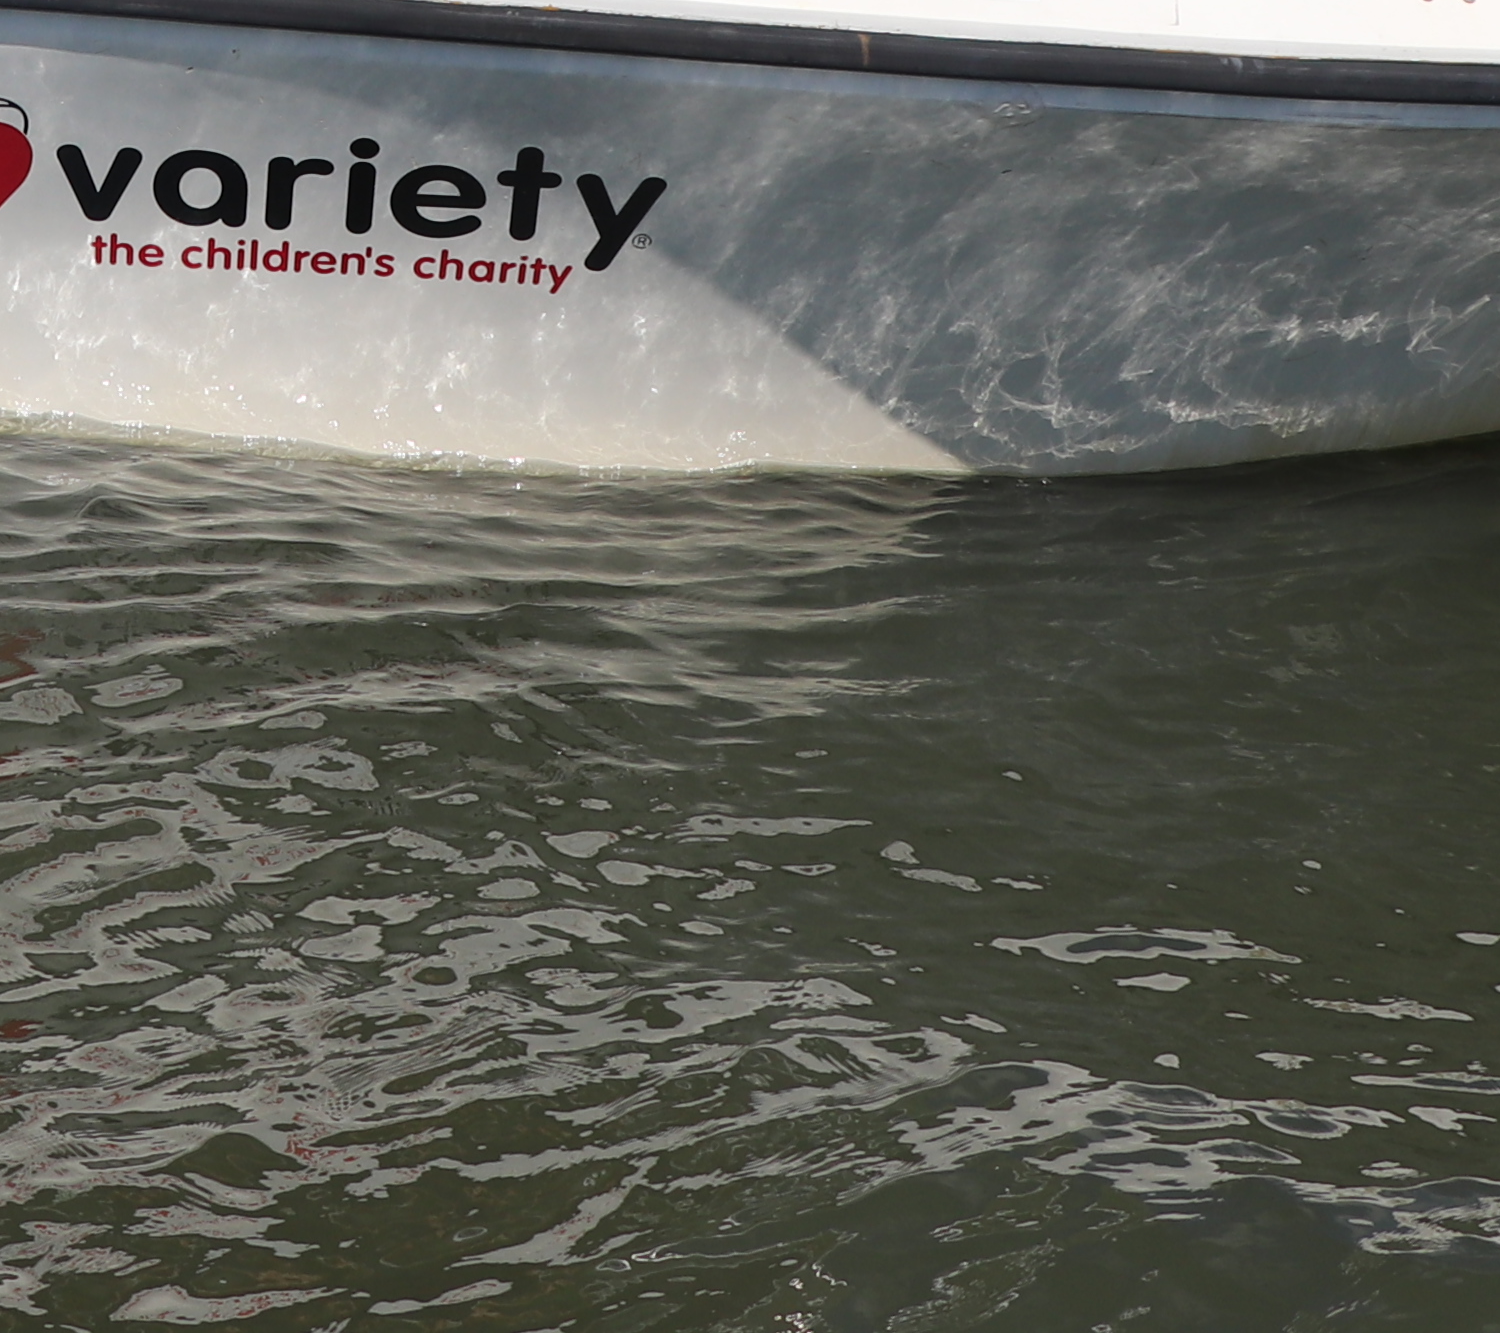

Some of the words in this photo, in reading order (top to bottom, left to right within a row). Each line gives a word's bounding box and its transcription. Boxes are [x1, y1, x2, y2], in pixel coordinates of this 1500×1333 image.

[56, 137, 667, 272] variety
[91, 233, 165, 270] the
[180, 237, 396, 279] children's
[412, 249, 574, 294] charity
